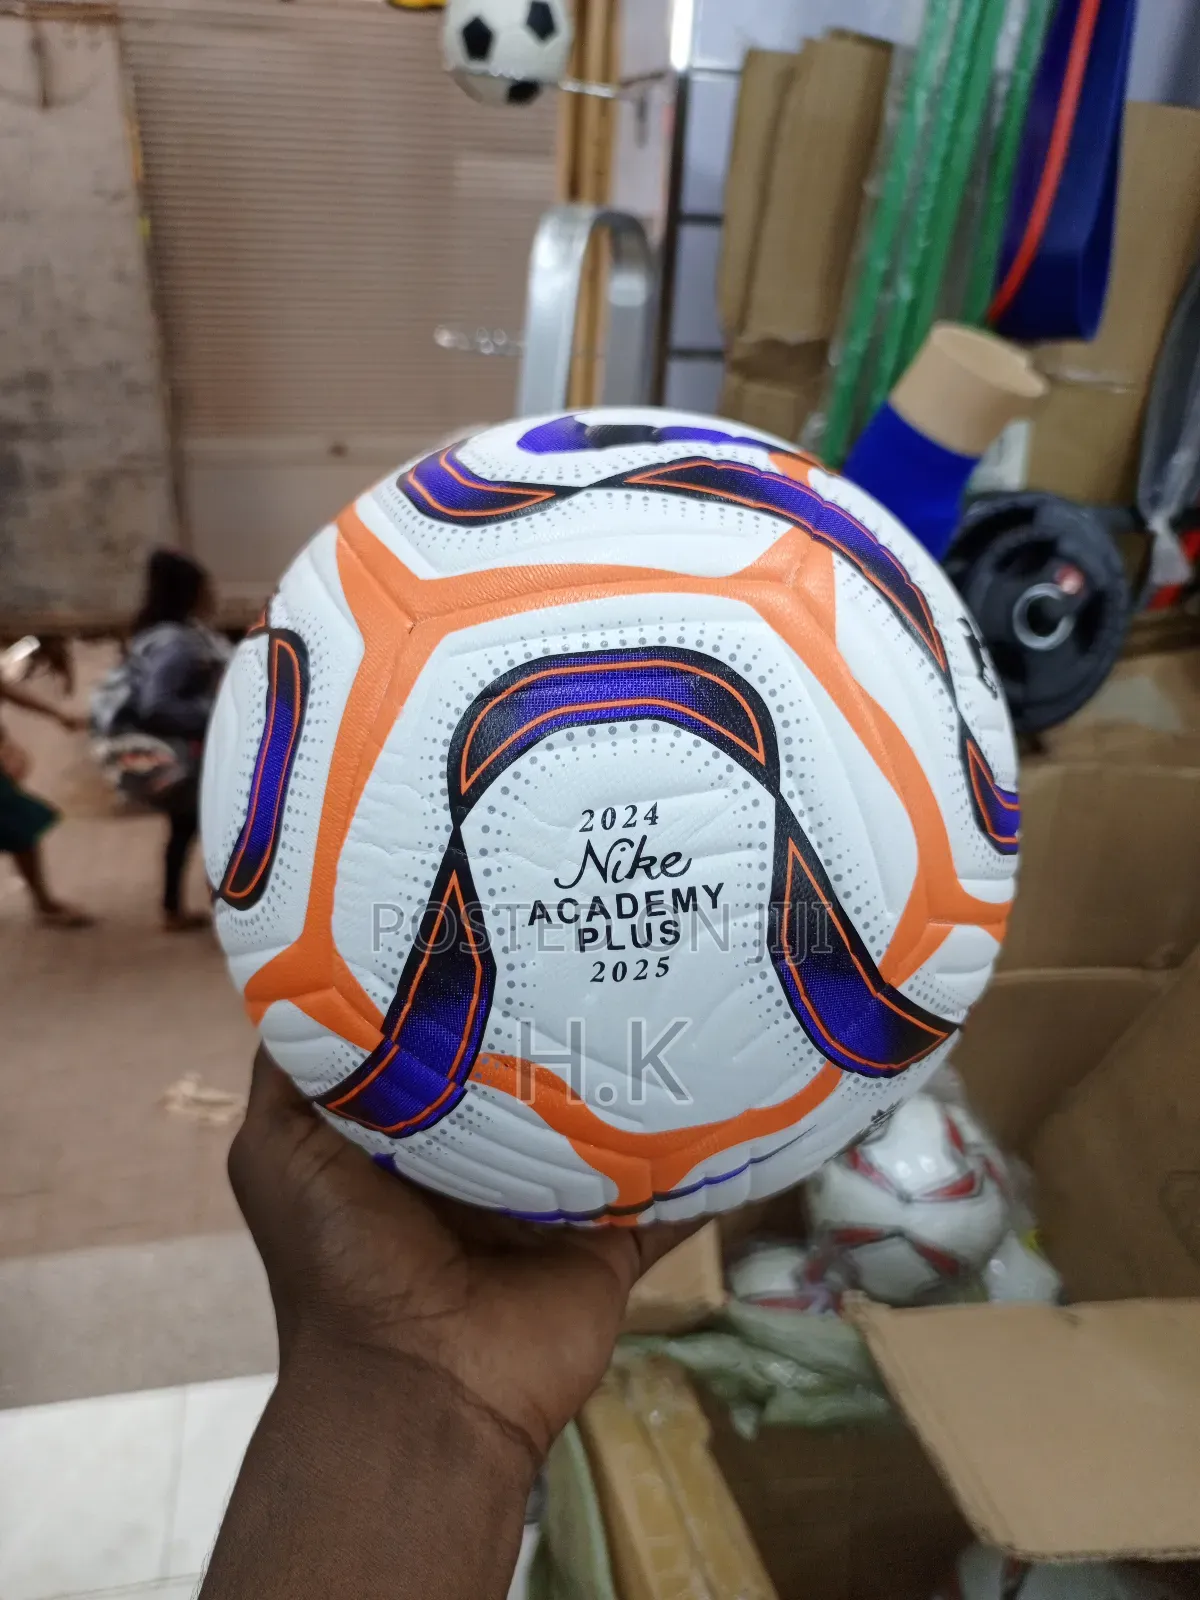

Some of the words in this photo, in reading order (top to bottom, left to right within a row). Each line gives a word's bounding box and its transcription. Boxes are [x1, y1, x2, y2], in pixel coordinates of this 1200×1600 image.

[578, 801, 660, 833] 2024
[554, 835, 692, 890] Nike
[527, 883, 725, 925] ACADEMY
[577, 920, 681, 953] PLUS
[589, 955, 671, 983] 2025
